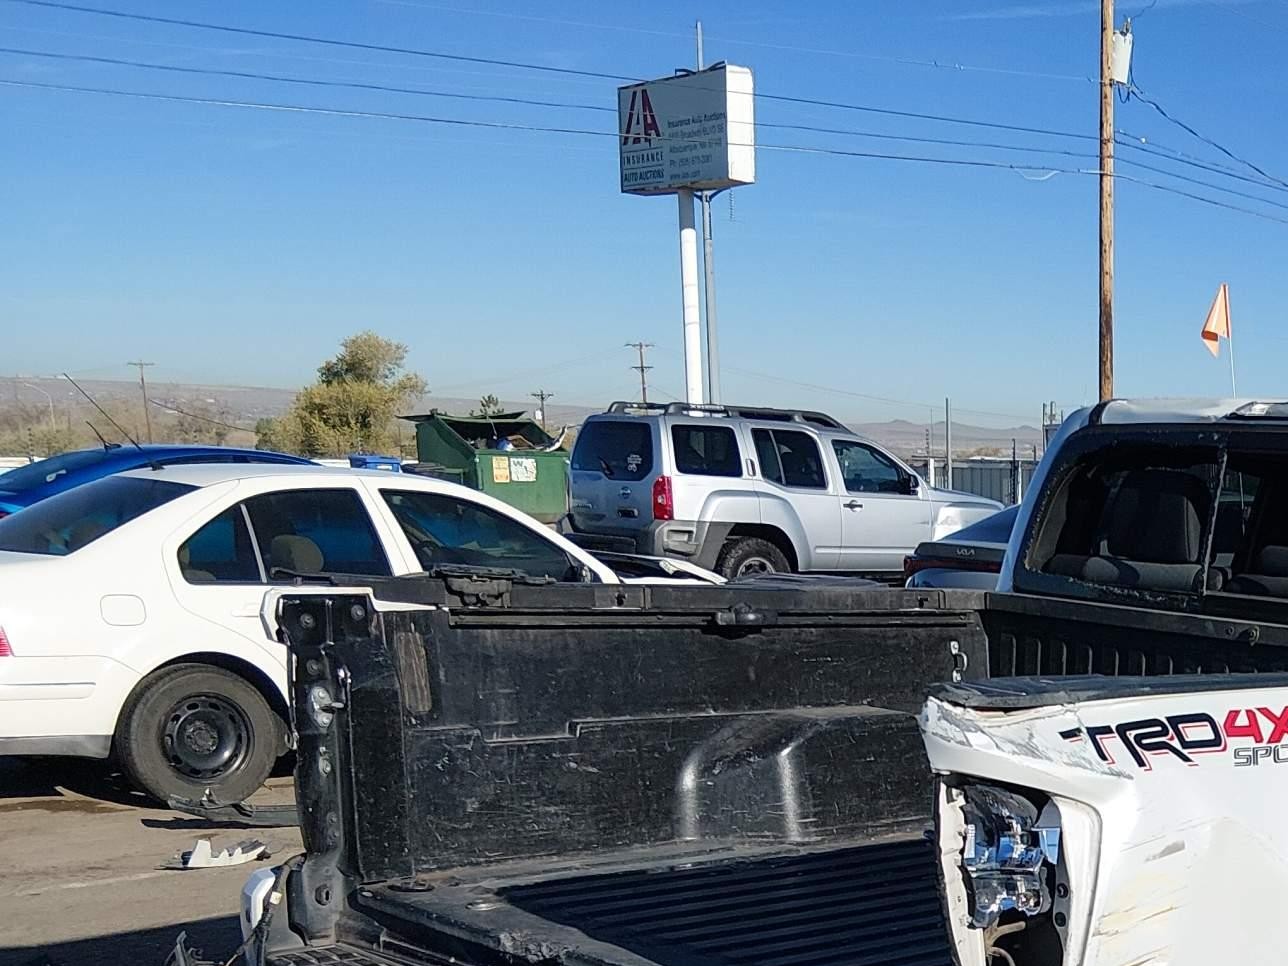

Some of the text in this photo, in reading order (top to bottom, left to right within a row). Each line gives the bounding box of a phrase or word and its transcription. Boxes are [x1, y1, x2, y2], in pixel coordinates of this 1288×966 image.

[623, 151, 664, 166] INSURANCE
[623, 170, 639, 181] AUTO
[638, 167, 665, 180] AUCTIONS
[1058, 712, 1226, 771] TRD
